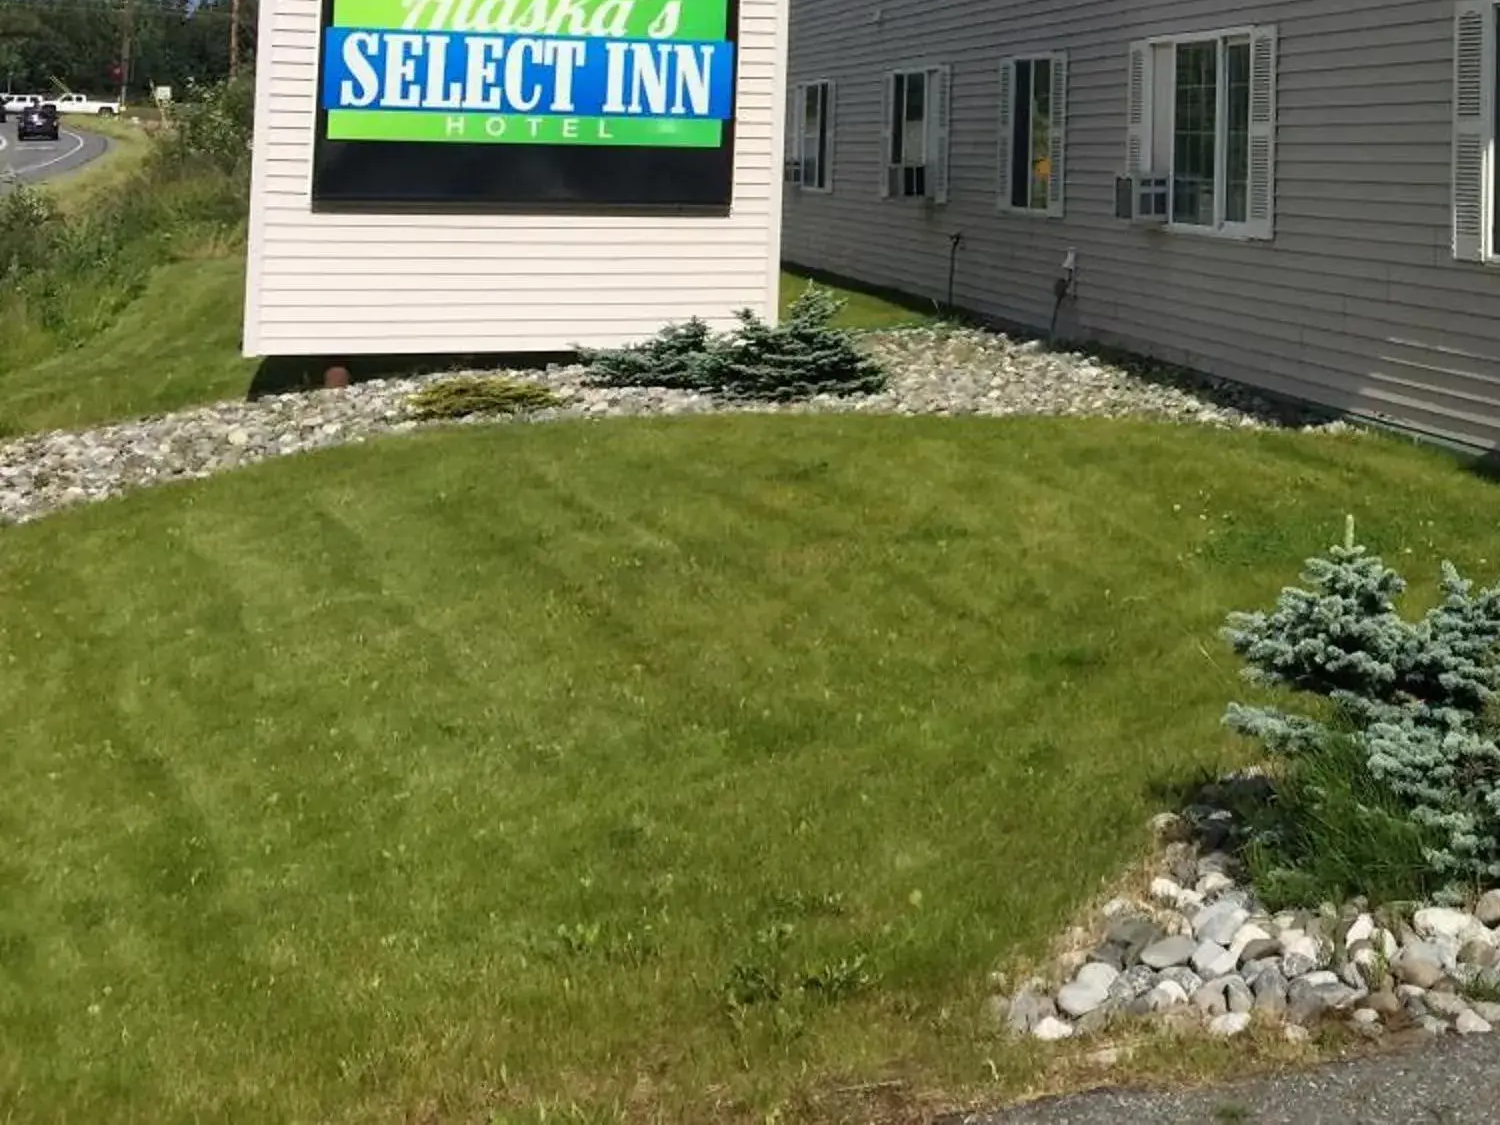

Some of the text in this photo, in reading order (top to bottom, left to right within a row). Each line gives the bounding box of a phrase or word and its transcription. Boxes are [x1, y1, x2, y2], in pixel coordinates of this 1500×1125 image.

[339, 31, 715, 115] SELECT INN
[445, 116, 614, 139] HOTEL
